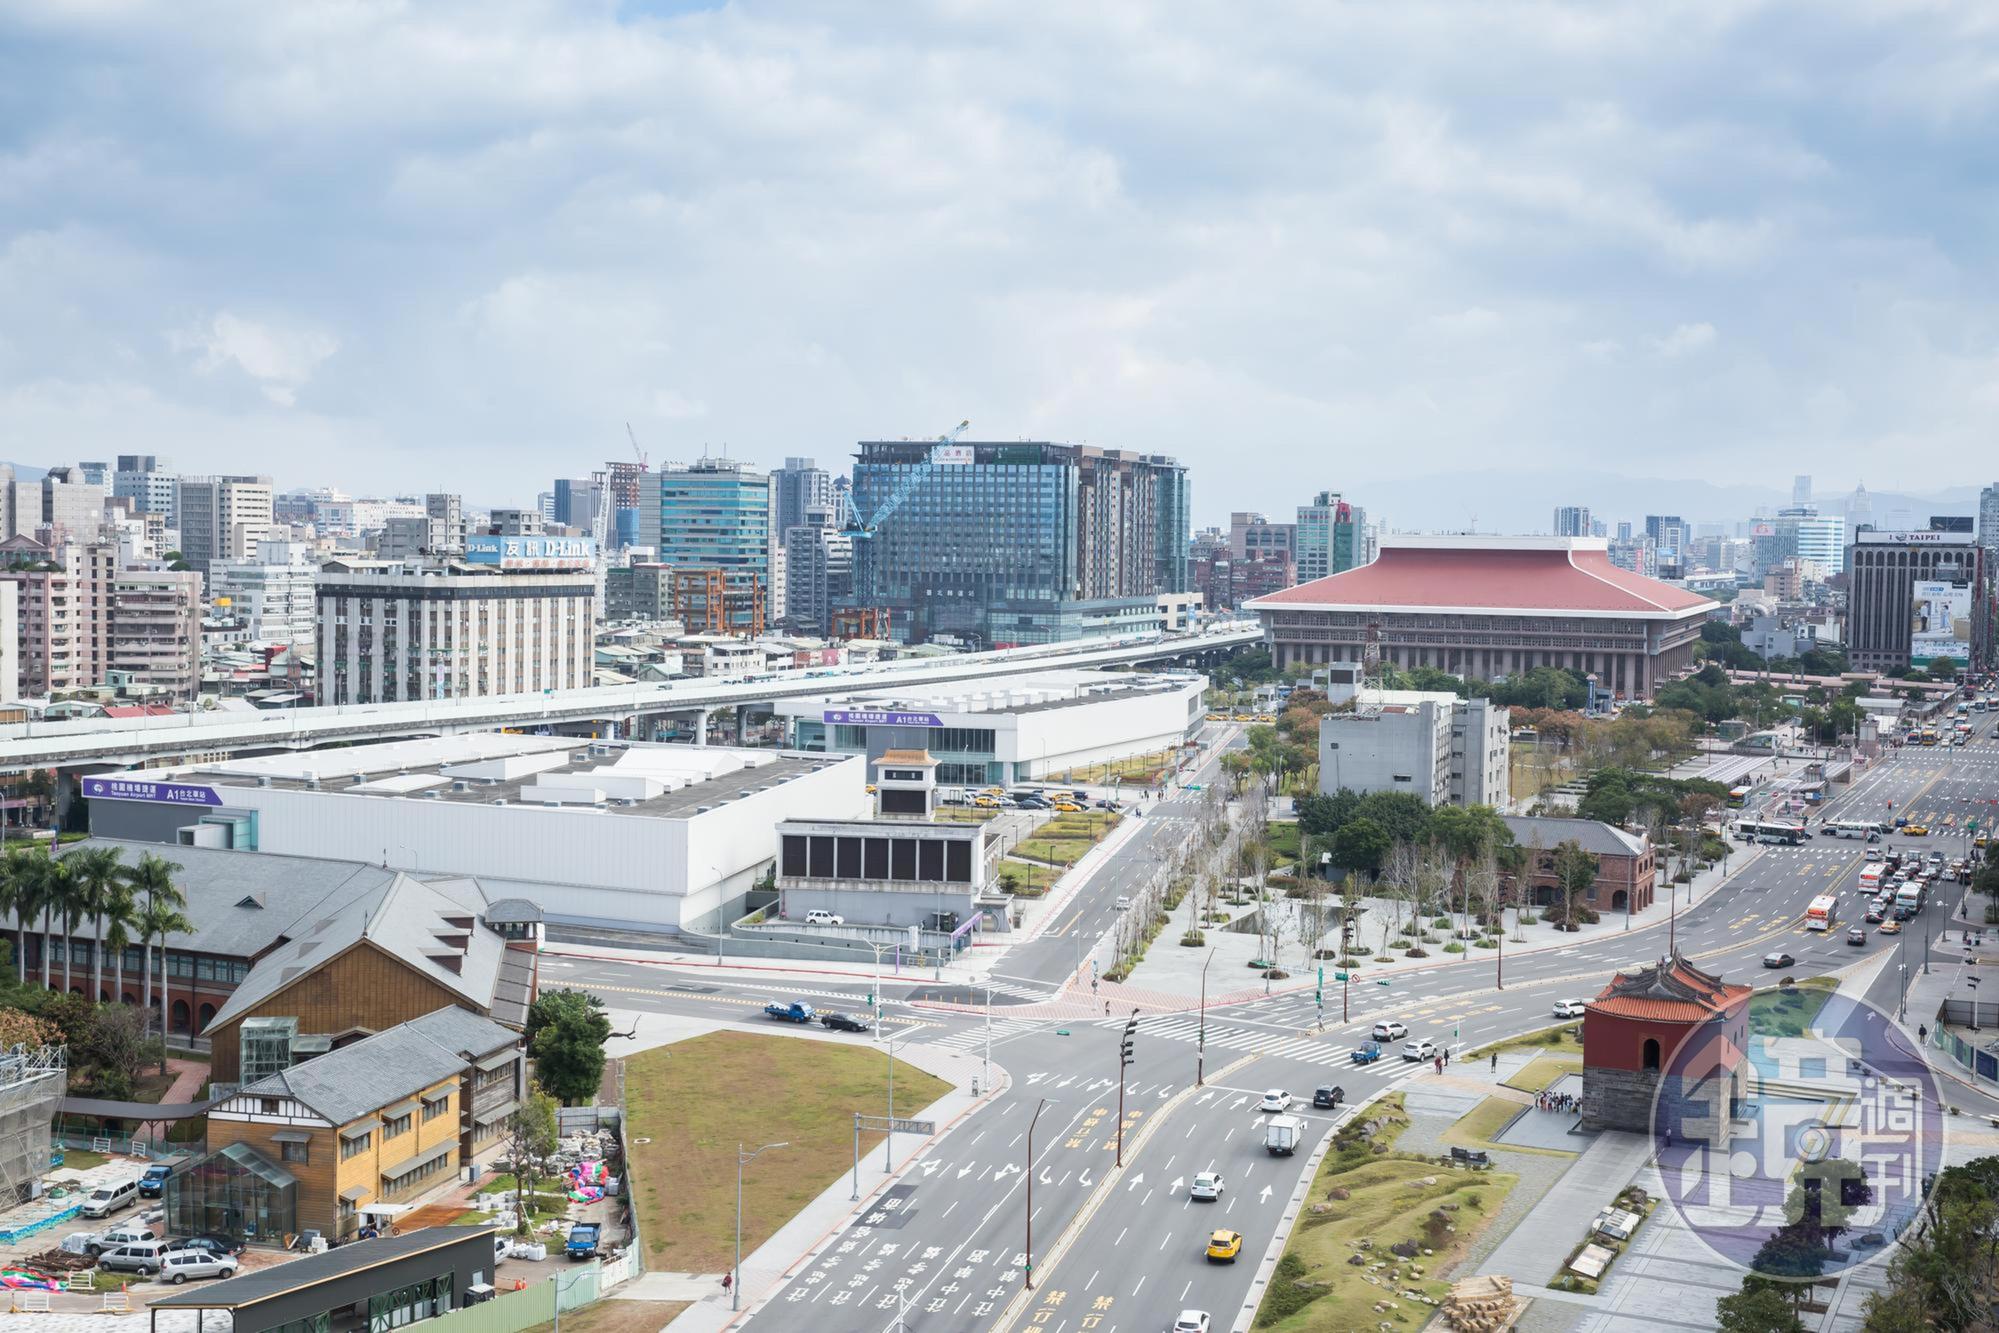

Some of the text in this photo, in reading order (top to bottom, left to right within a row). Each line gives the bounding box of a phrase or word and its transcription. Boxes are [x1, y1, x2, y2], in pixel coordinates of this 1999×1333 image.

[468, 543, 498, 553] D-Link
[545, 541, 590, 557] D-Link
[111, 782, 157, 794] 桃園機場捷運
[166, 789, 179, 800] A1
[925, 1249, 990, 1313] 往中華路
